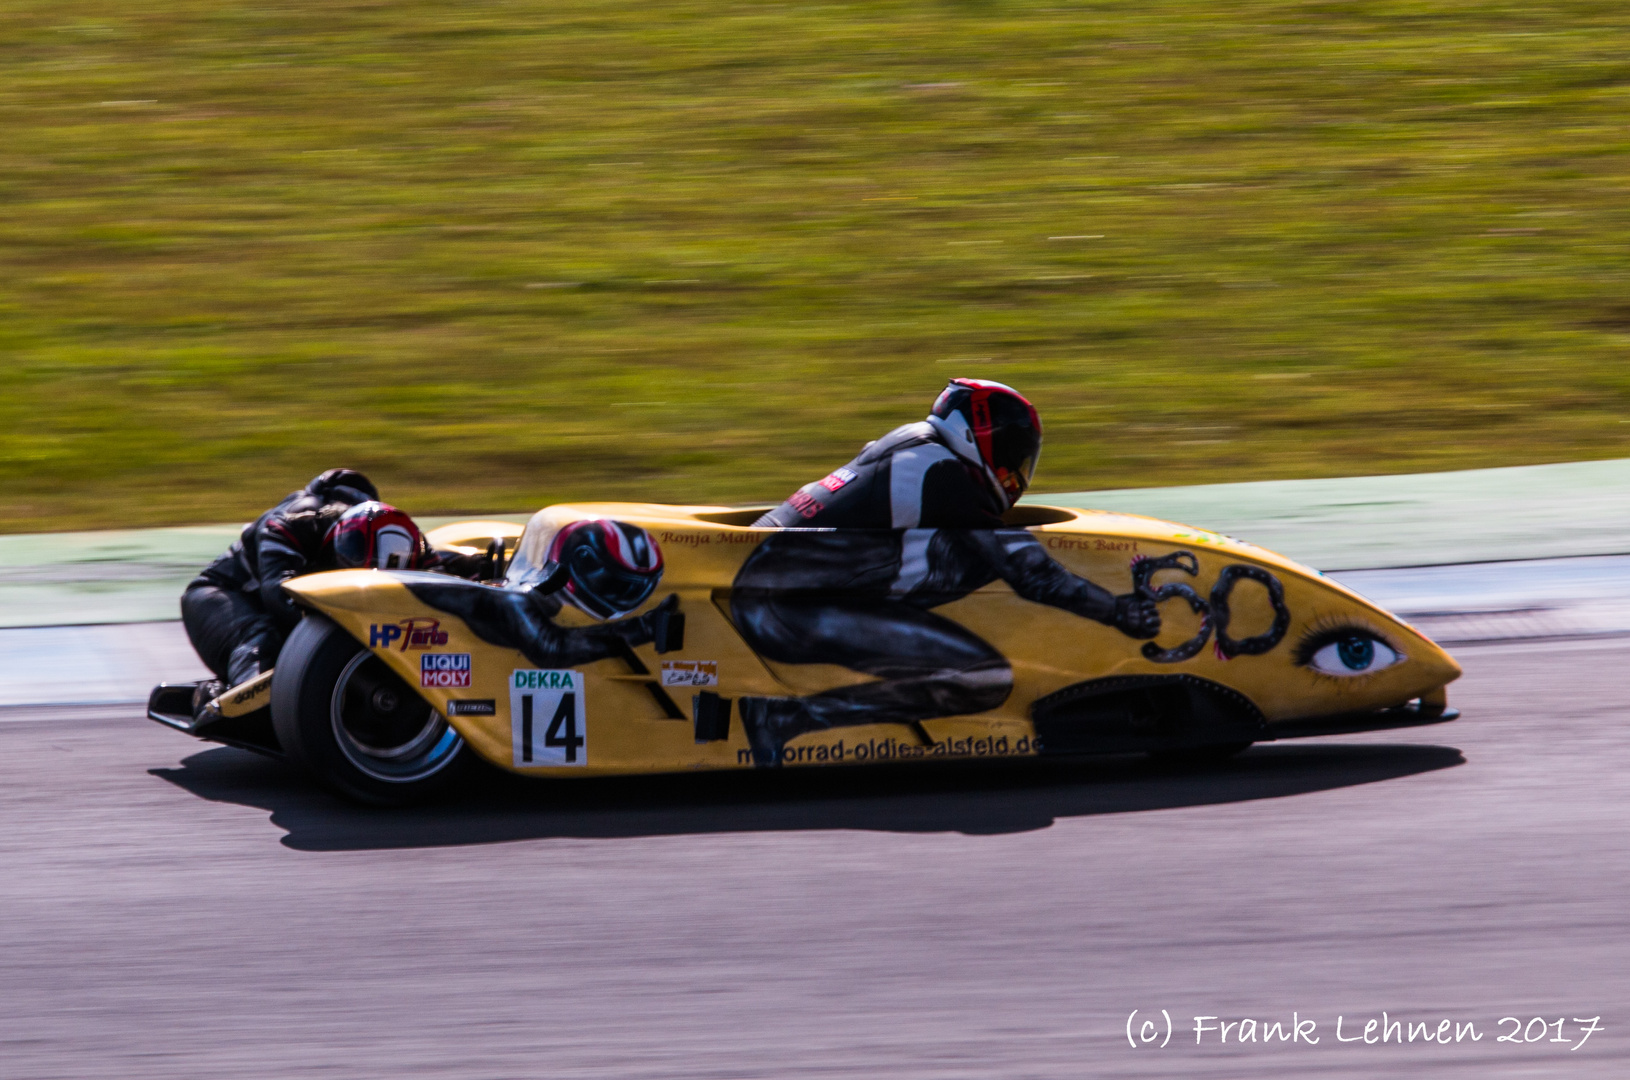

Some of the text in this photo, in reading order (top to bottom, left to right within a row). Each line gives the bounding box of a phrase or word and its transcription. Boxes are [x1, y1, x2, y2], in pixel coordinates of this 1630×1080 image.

[786, 490, 824, 519] HRIS
[661, 531, 711, 548] Ronja
[1047, 536, 1138, 551] Chris Baert
[1131, 550, 1290, 663] 50
[369, 623, 402, 648] HP
[423, 654, 469, 670] LIQUI
[423, 671, 468, 686] MOLY
[515, 671, 574, 689] DEKRA
[521, 691, 584, 763] 14
[737, 735, 1041, 764] morrad-oldies-alsfeld.de
